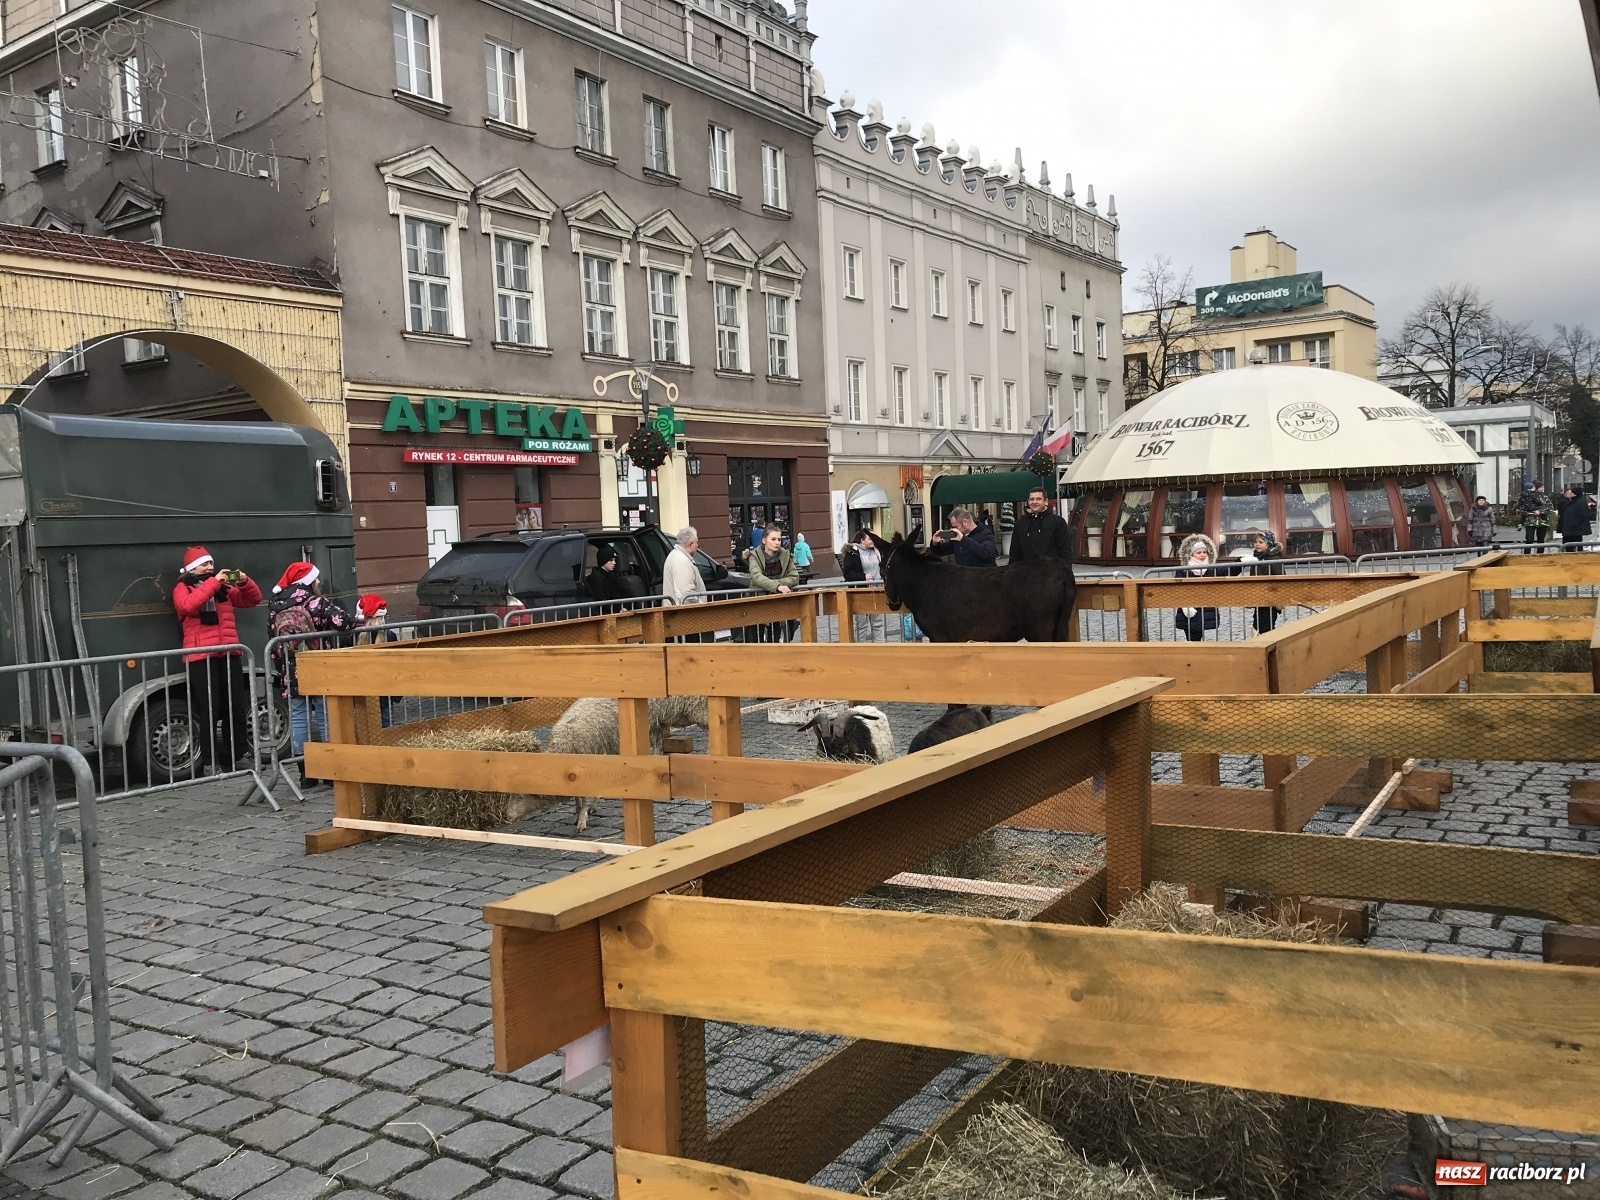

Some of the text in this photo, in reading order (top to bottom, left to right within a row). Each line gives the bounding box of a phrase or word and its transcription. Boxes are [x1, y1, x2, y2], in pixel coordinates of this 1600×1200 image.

[1226, 287, 1290, 304] McDonald's
[381, 395, 592, 440] APTEKA
[1109, 420, 1163, 439] BROWAR
[1161, 413, 1250, 430] RACIBÓRZ
[1311, 416, 1335, 427] 1567
[528, 440, 589, 451] POD RÓŻAMI
[1136, 439, 1175, 458] 1567
[411, 452, 443, 460] RYNEK
[463, 453, 504, 462] CENTRUM
[506, 454, 576, 464] FARMACEUTYCZNE
